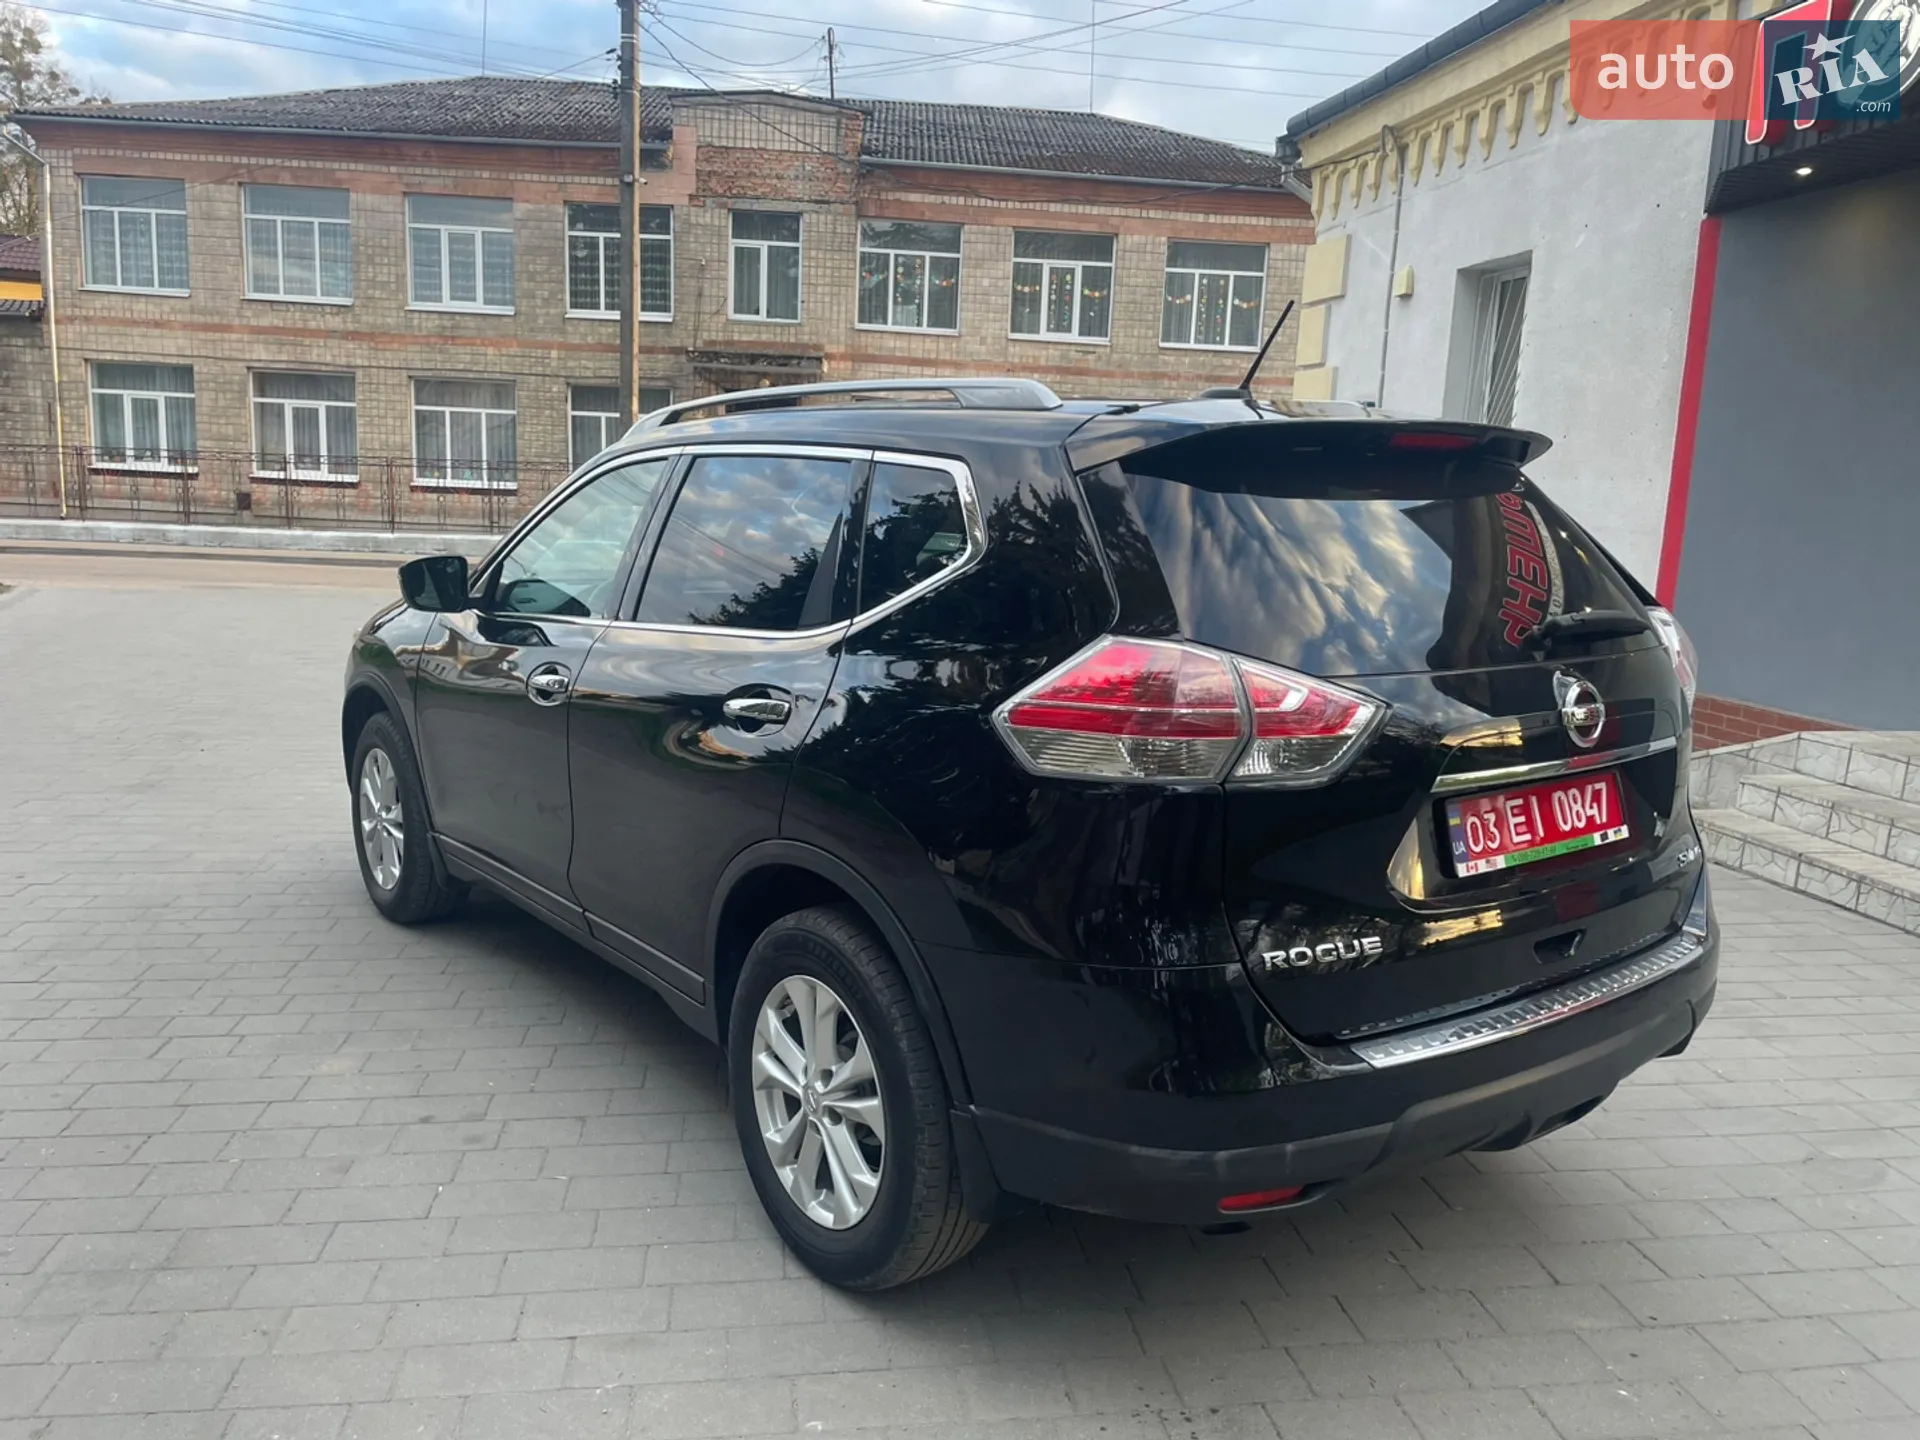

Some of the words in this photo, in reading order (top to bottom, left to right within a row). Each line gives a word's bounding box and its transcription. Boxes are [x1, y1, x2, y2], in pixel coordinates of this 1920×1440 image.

[1466, 812, 1500, 853] 03
[1506, 795, 1544, 843] EI
[1552, 782, 1607, 832] 0847
[1453, 841, 1466, 855] UA
[1261, 936, 1384, 971] ROGUE
